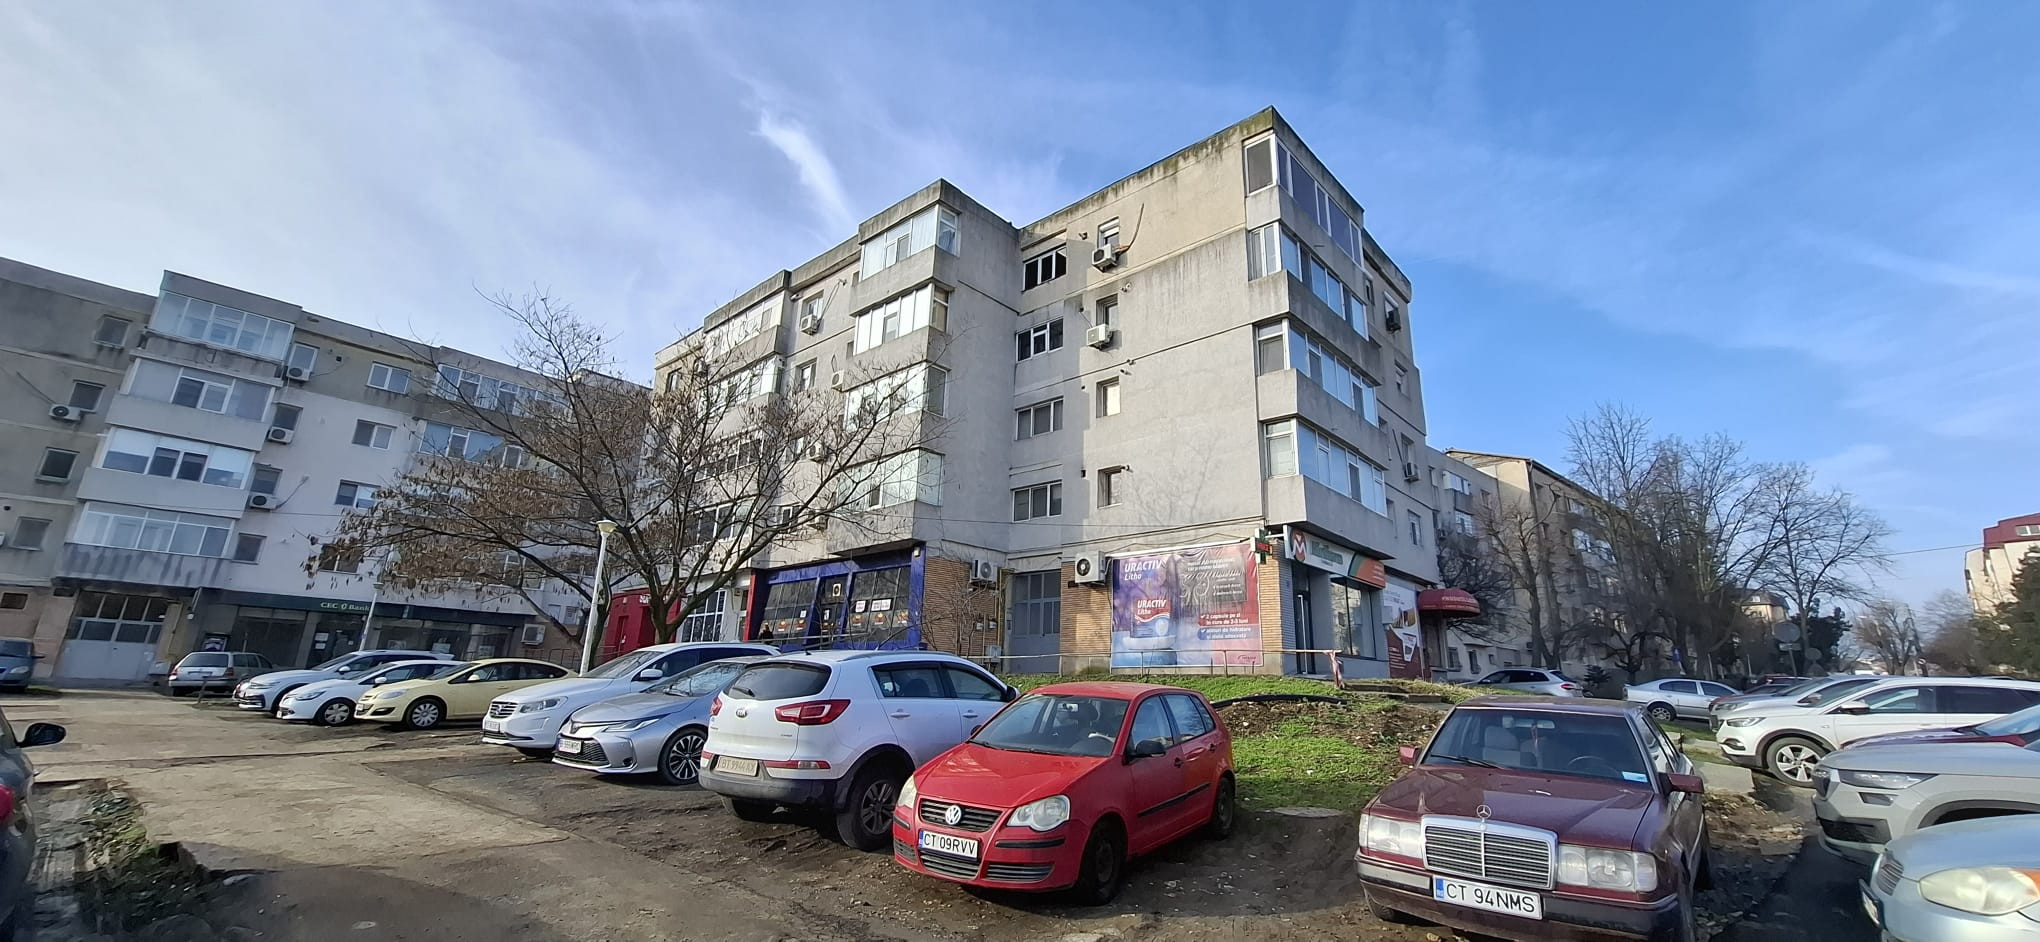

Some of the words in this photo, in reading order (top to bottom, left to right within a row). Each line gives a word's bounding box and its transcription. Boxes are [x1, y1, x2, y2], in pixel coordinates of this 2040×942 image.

[1124, 560, 1163, 572] URACTIV
[1124, 572, 1142, 581] Litho
[1137, 599, 1167, 609] URACTIV
[924, 833, 937, 846] CT
[939, 836, 976, 855] 09RVV
[1446, 883, 1467, 901] CT
[1474, 888, 1535, 913] 94NMS
